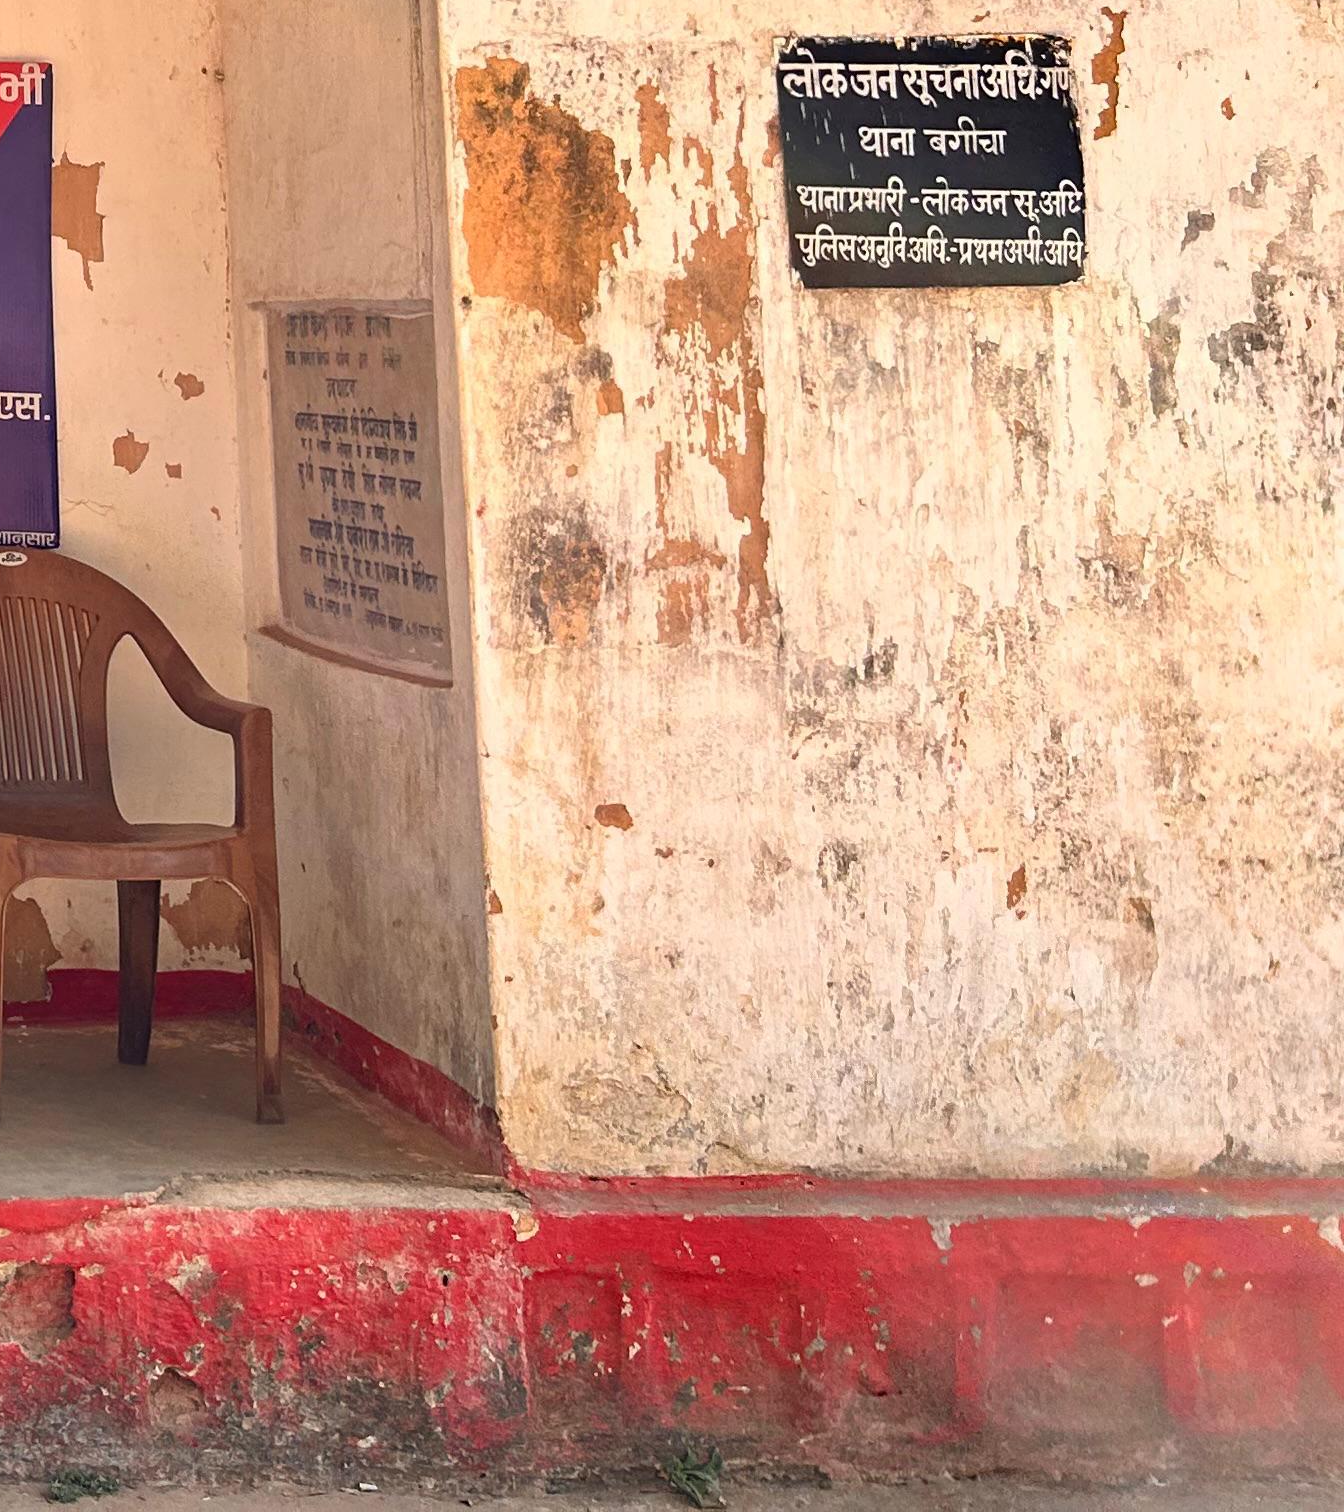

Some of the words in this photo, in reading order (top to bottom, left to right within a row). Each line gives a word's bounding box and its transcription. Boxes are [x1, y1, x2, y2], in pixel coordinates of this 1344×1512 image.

[0, 62, 47, 106] भी
[779, 48, 848, 99] लोक
[857, 126, 916, 157] थाना
[922, 116, 1007, 156] बगीचा
